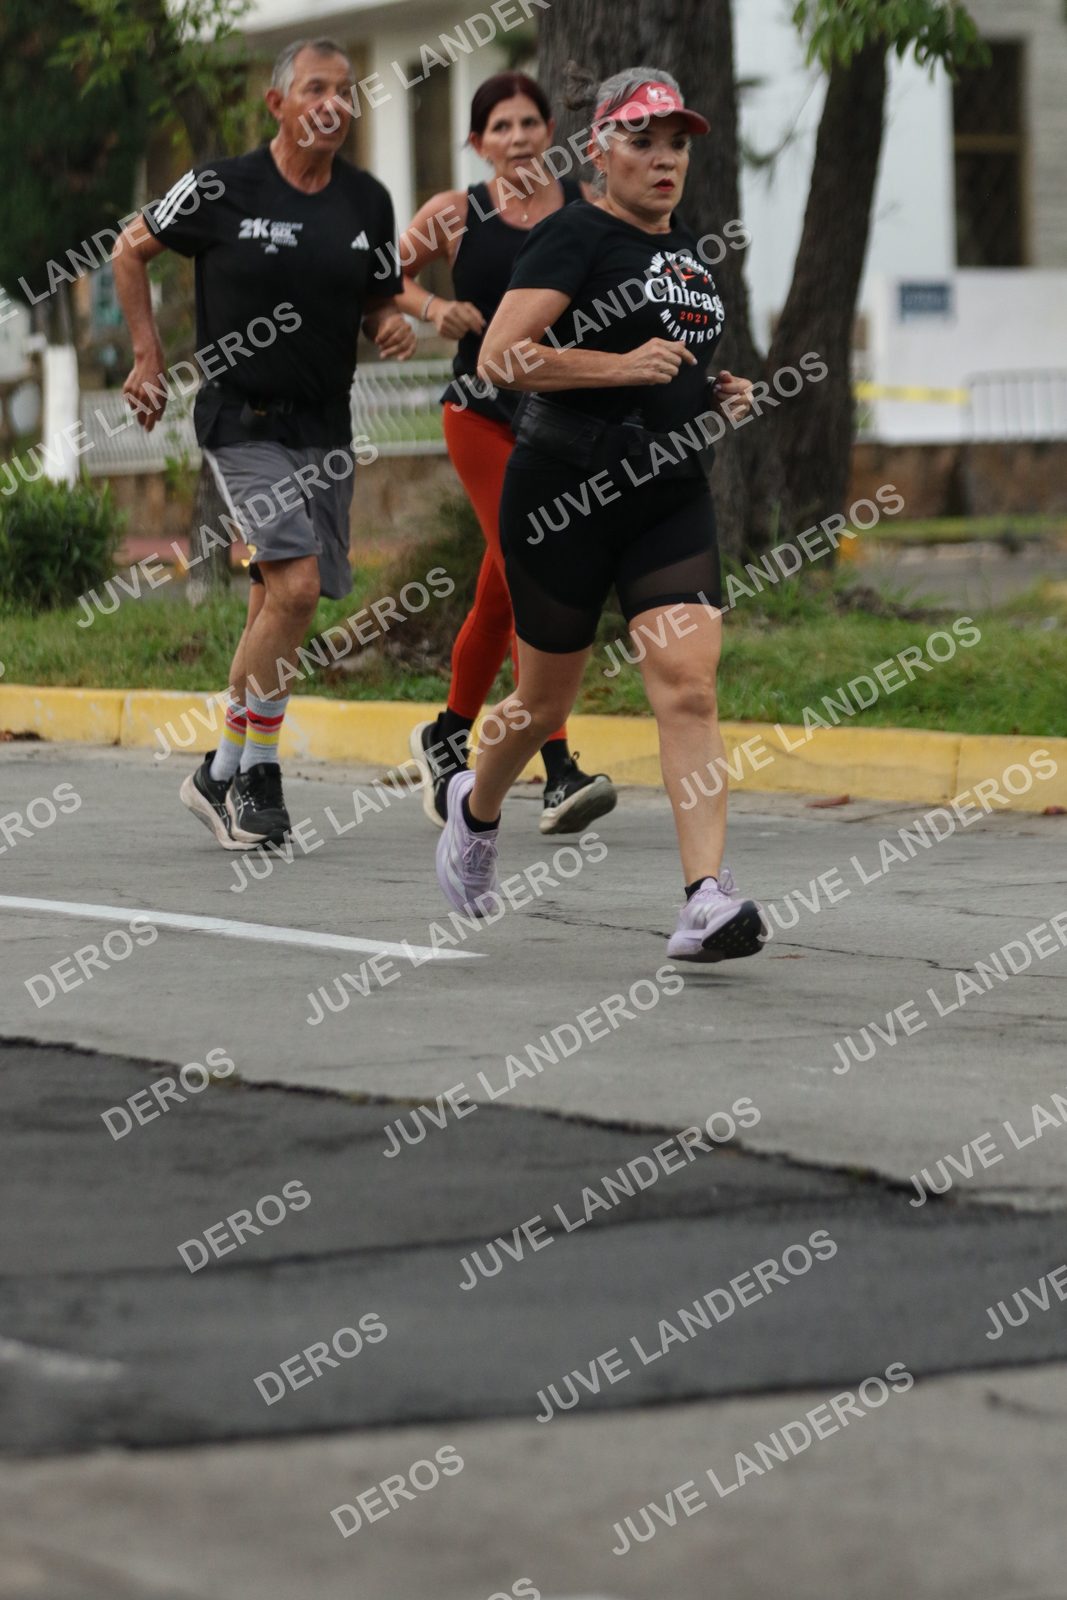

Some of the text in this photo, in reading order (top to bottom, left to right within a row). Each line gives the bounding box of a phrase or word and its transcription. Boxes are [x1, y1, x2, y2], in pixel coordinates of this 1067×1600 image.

[644, 276, 725, 322] Chicag
[660, 308, 723, 344] MARATHON
[680, 310, 709, 326] 2021
